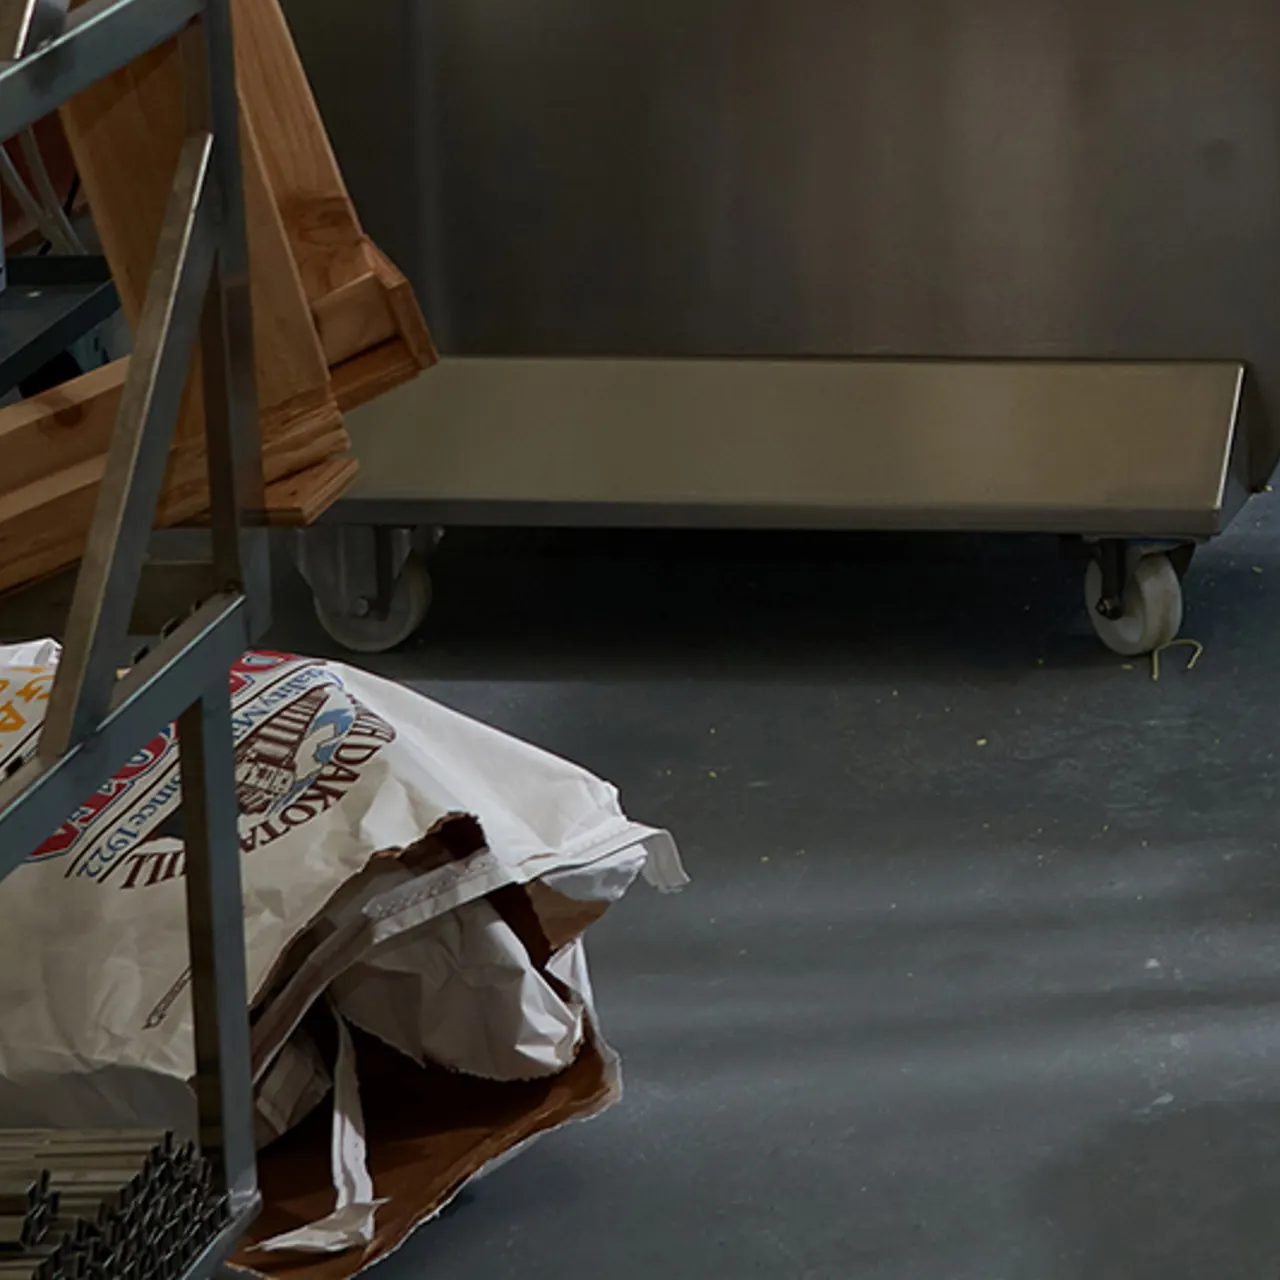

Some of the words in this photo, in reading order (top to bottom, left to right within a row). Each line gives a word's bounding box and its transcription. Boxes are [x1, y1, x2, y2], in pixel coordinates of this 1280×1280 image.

[240, 742, 382, 854] DAKOTA
[76, 824, 140, 878] 1922
[119, 848, 187, 890] ILL
